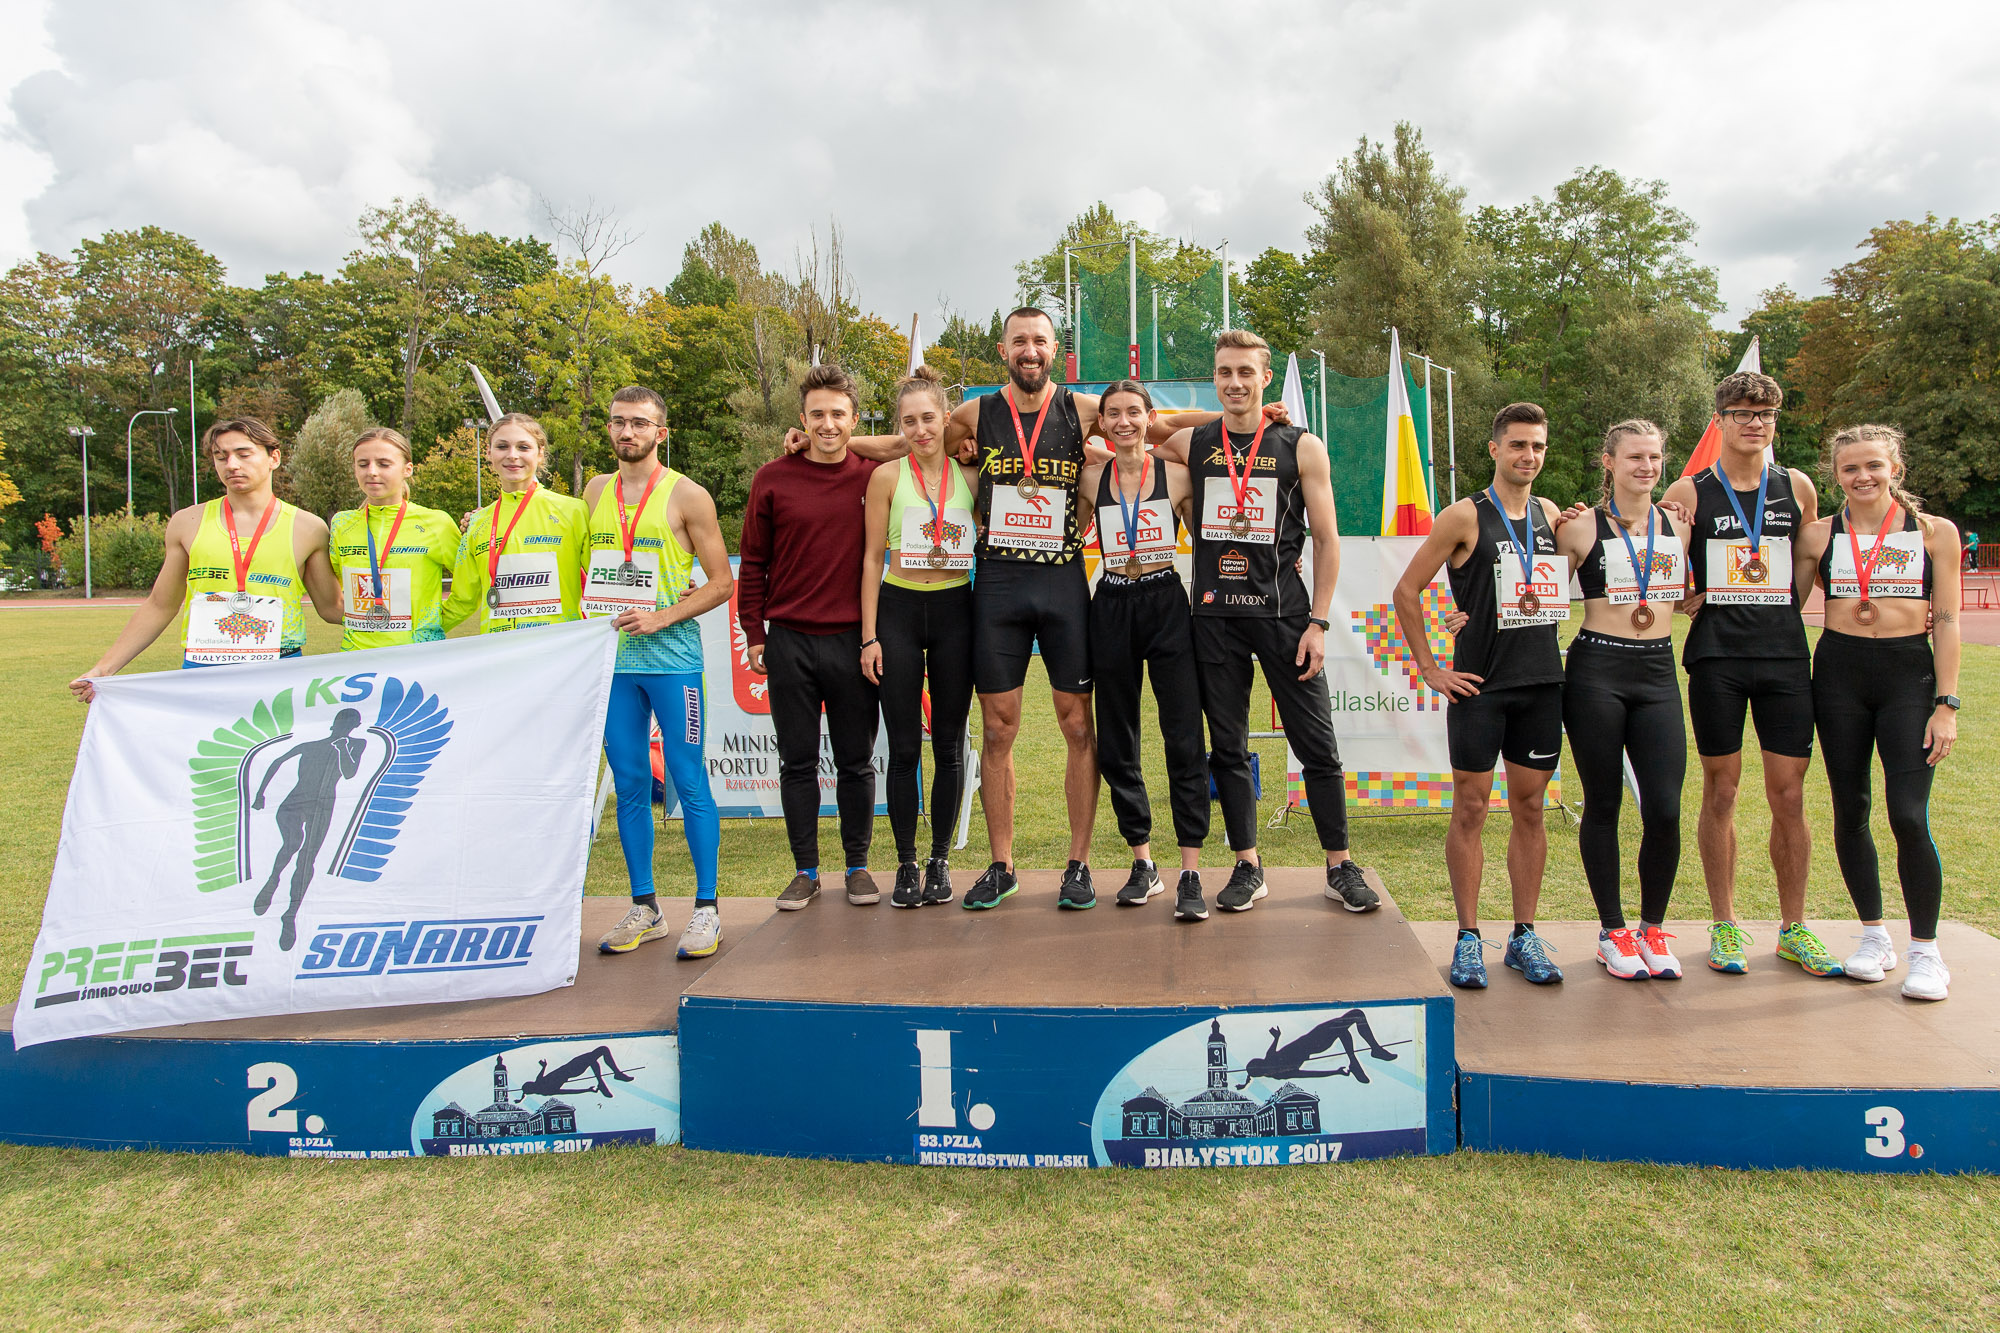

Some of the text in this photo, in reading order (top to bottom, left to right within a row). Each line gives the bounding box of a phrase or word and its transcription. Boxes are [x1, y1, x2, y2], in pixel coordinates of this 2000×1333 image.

[1006, 514, 1050, 527] ORLEN
[993, 538, 1058, 548] BIAŁYSTOK 2022
[1118, 529, 1160, 543] OLEN
[1154, 552, 1174, 560] 2022
[495, 572, 551, 588] SONAROL
[1892, 586, 1917, 594] 2022
[494, 606, 557, 616] BIAŁYSTOK 2022
[586, 602, 630, 612] BIAŁYSTOK
[305, 672, 378, 708] KS
[297, 917, 543, 978] SONAROL
[80, 982, 154, 1000] ŚNIADOWO
[247, 1061, 326, 1134] 2.
[1864, 1106, 1924, 1158] 3.
[449, 1138, 593, 1157] BIAŁYSTOK 2017
[1144, 1142, 1344, 1168] BIAŁYSTOK 2017
[920, 1151, 1089, 1168] MISTRZOSTWA POLSKI
